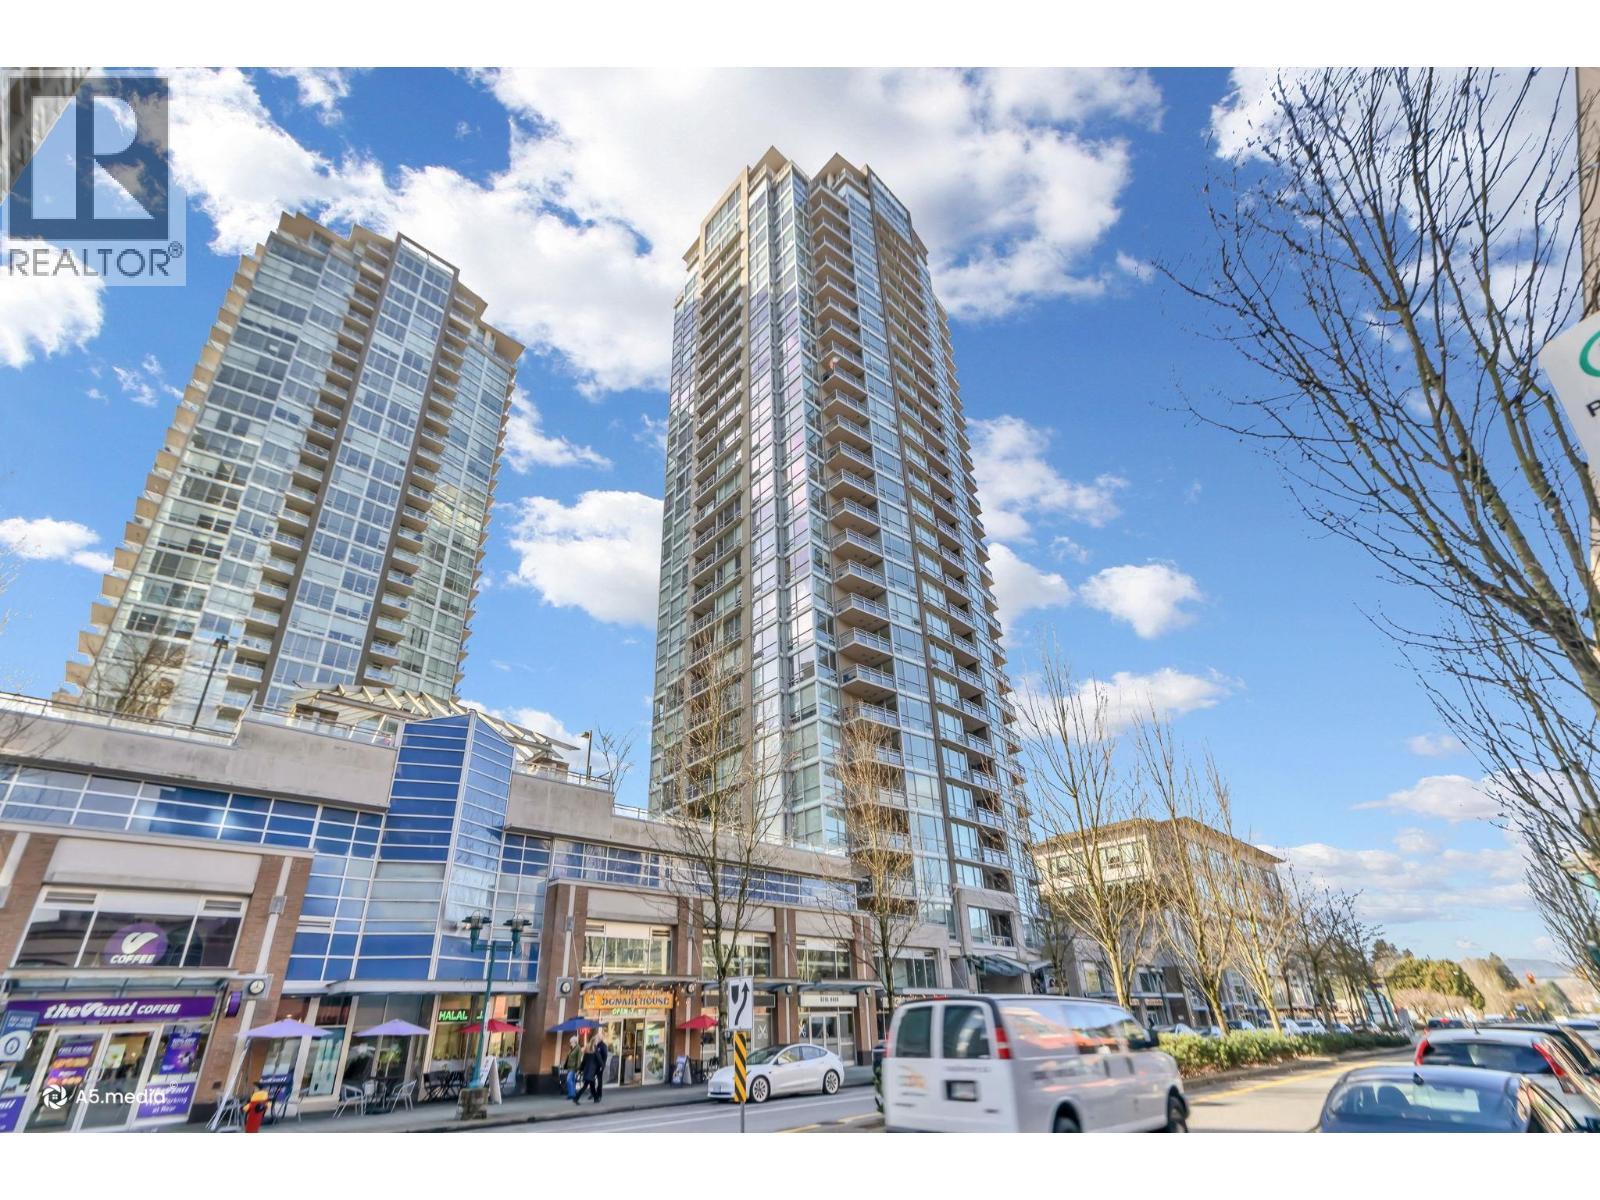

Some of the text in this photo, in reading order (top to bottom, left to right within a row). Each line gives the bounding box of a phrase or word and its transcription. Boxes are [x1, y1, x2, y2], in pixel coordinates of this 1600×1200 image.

[109, 954, 156, 964] COFFEE
[43, 1001, 181, 1019] theVenti COFFEE
[438, 1010, 468, 1021] HALAL
